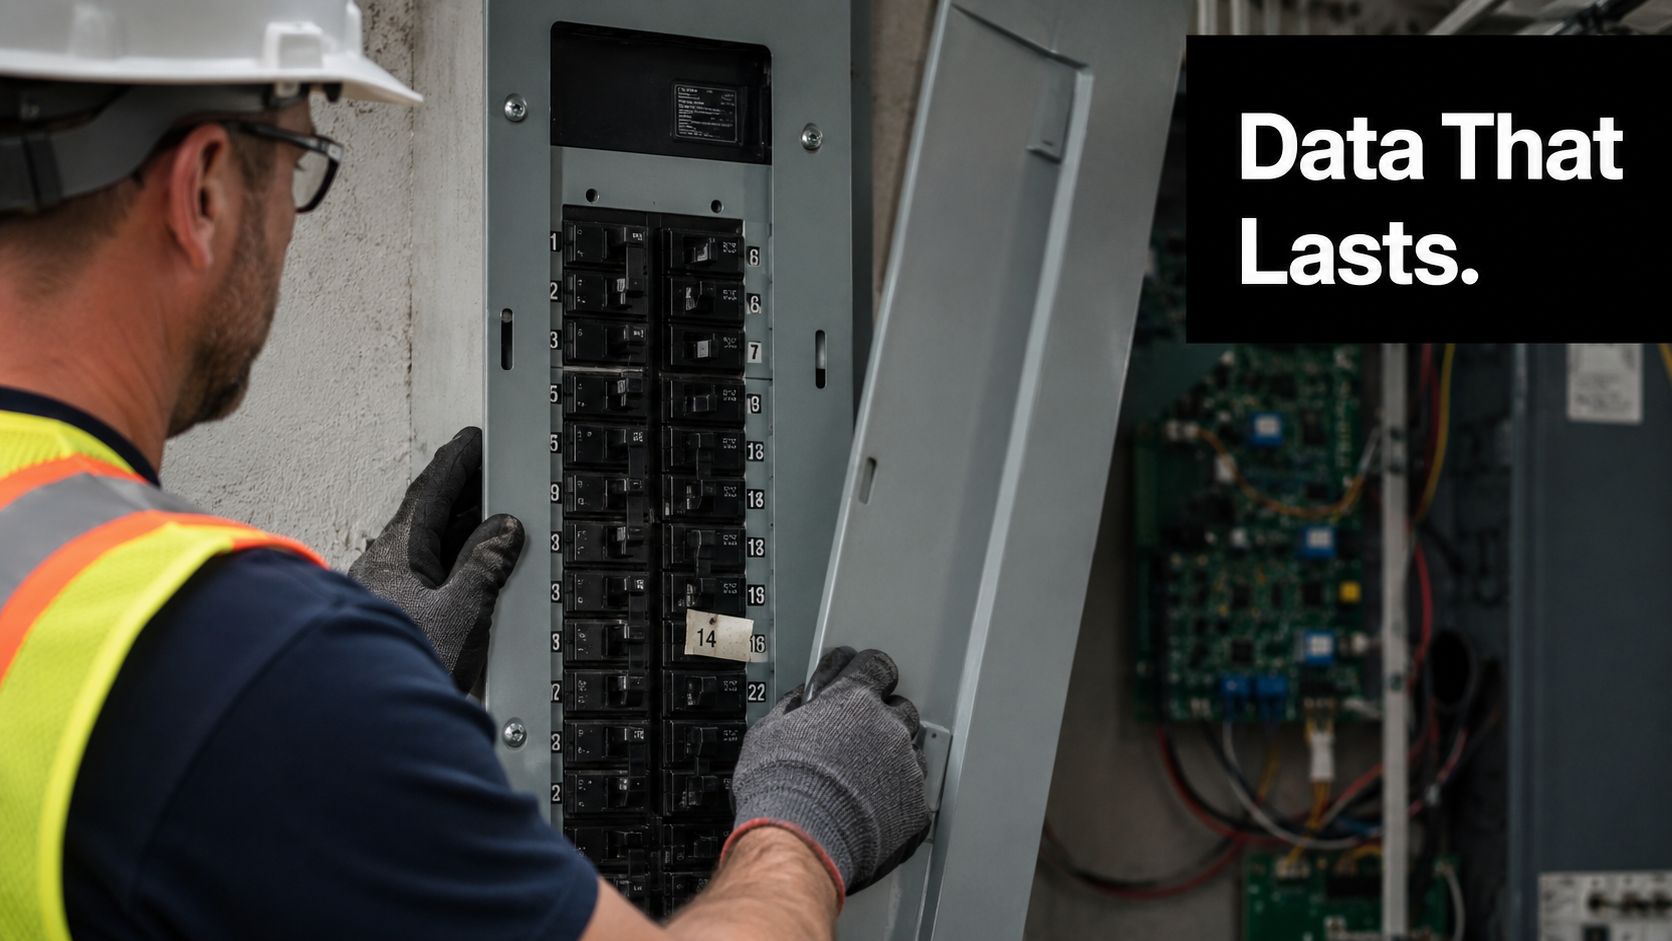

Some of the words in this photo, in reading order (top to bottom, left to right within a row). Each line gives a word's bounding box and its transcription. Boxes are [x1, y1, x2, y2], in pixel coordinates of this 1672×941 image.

[550, 232, 557, 251] 1
[550, 282, 558, 300] 2
[550, 331, 559, 349] 3
[750, 345, 759, 360] 7
[550, 385, 558, 403] 5
[550, 434, 559, 452] 5
[550, 484, 560, 501] 9
[697, 628, 717, 648] 14
[748, 683, 766, 701] 22
